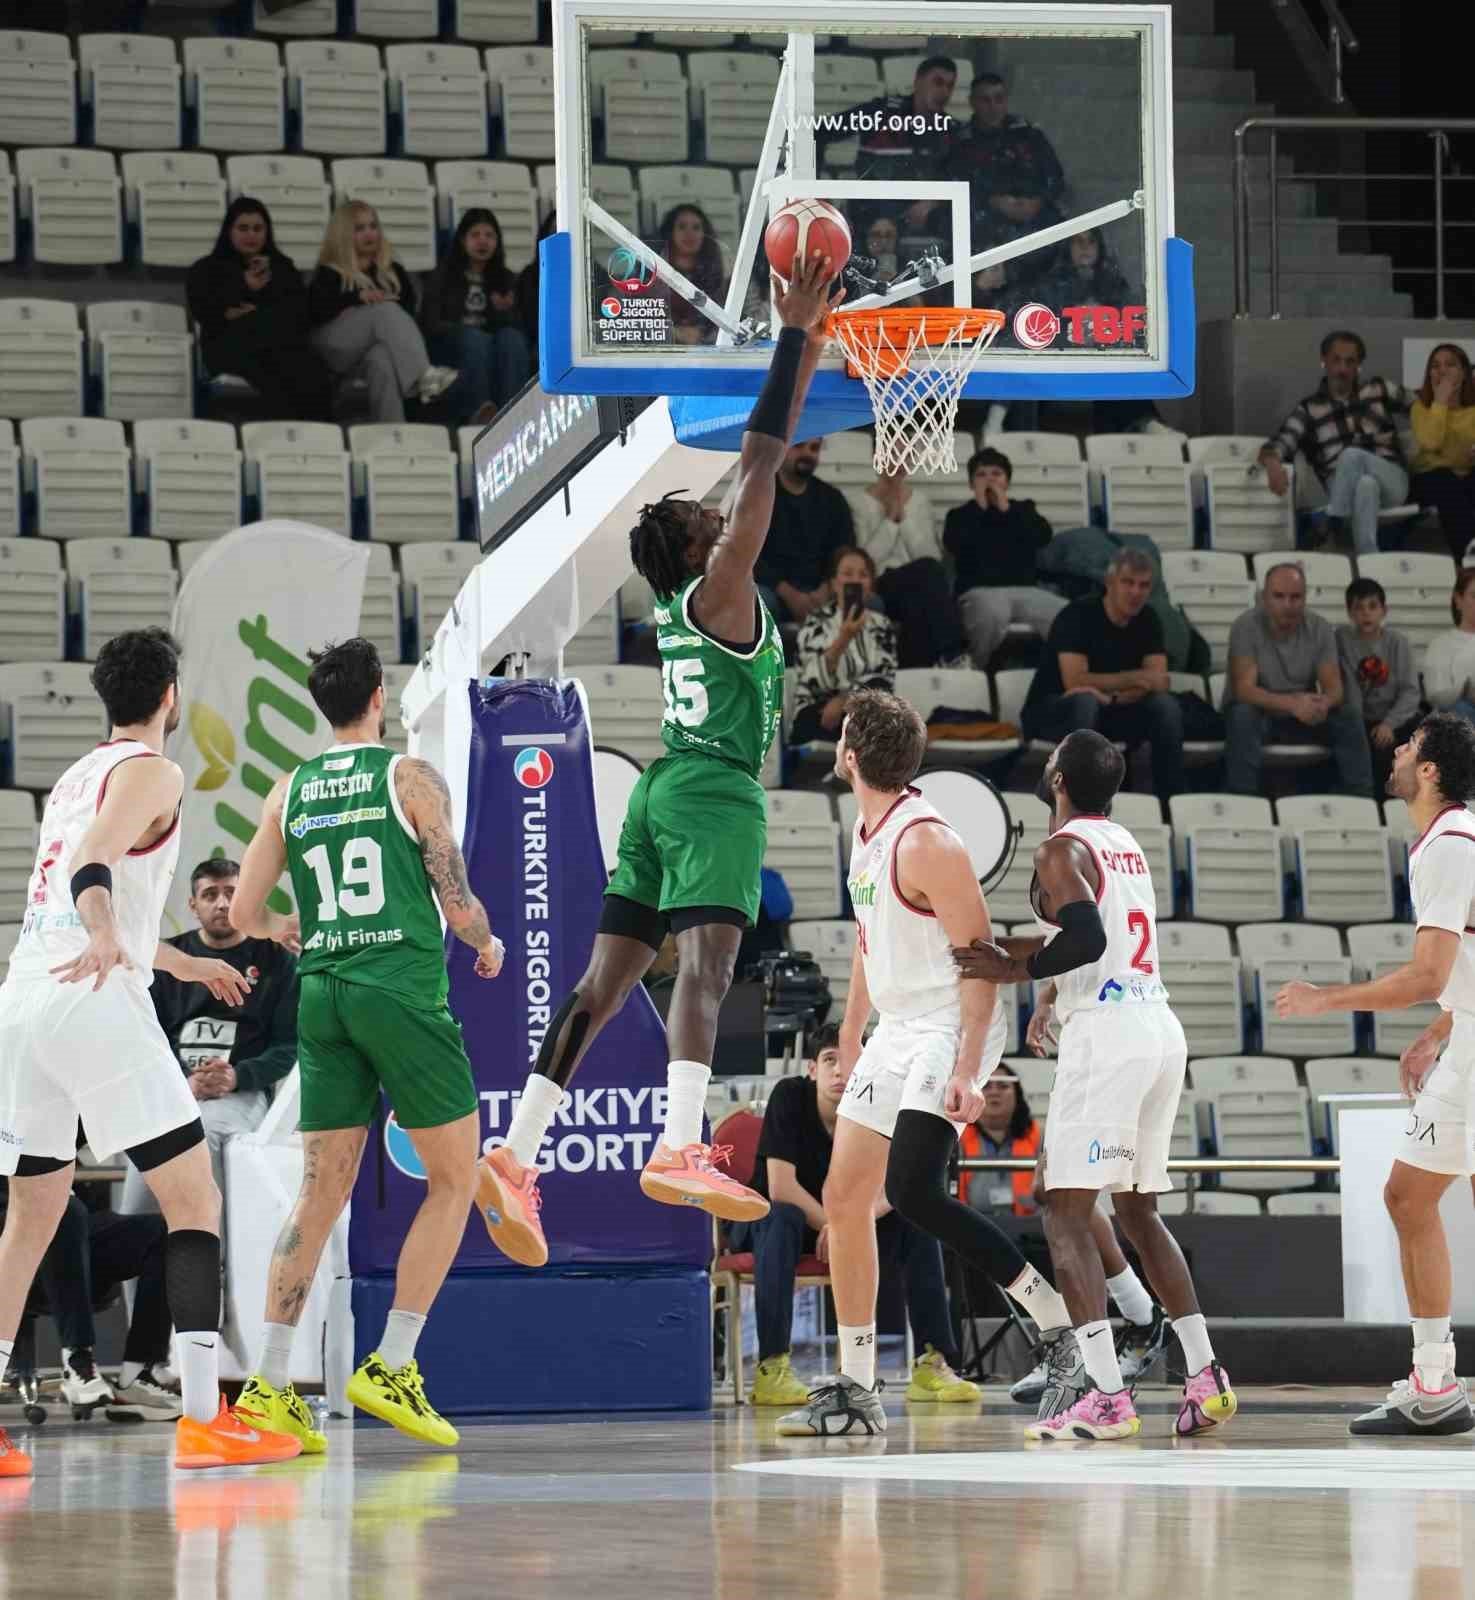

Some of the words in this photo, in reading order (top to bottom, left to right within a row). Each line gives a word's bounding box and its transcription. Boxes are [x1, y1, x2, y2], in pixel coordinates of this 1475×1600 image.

[782, 110, 952, 135] www.tbf.org.tr
[599, 318, 669, 329] BASKETBOL
[603, 329, 641, 341] SÜPER
[1062, 305, 1147, 344] TBF
[476, 394, 583, 512] MEDICANA
[210, 613, 320, 916] lint
[302, 836, 385, 922] 19
[347, 928, 403, 946] Finans
[1127, 909, 1154, 975] 2
[194, 1020, 225, 1039] TV
[482, 1132, 664, 1173] GORT
[855, 1332, 873, 1346] 23
